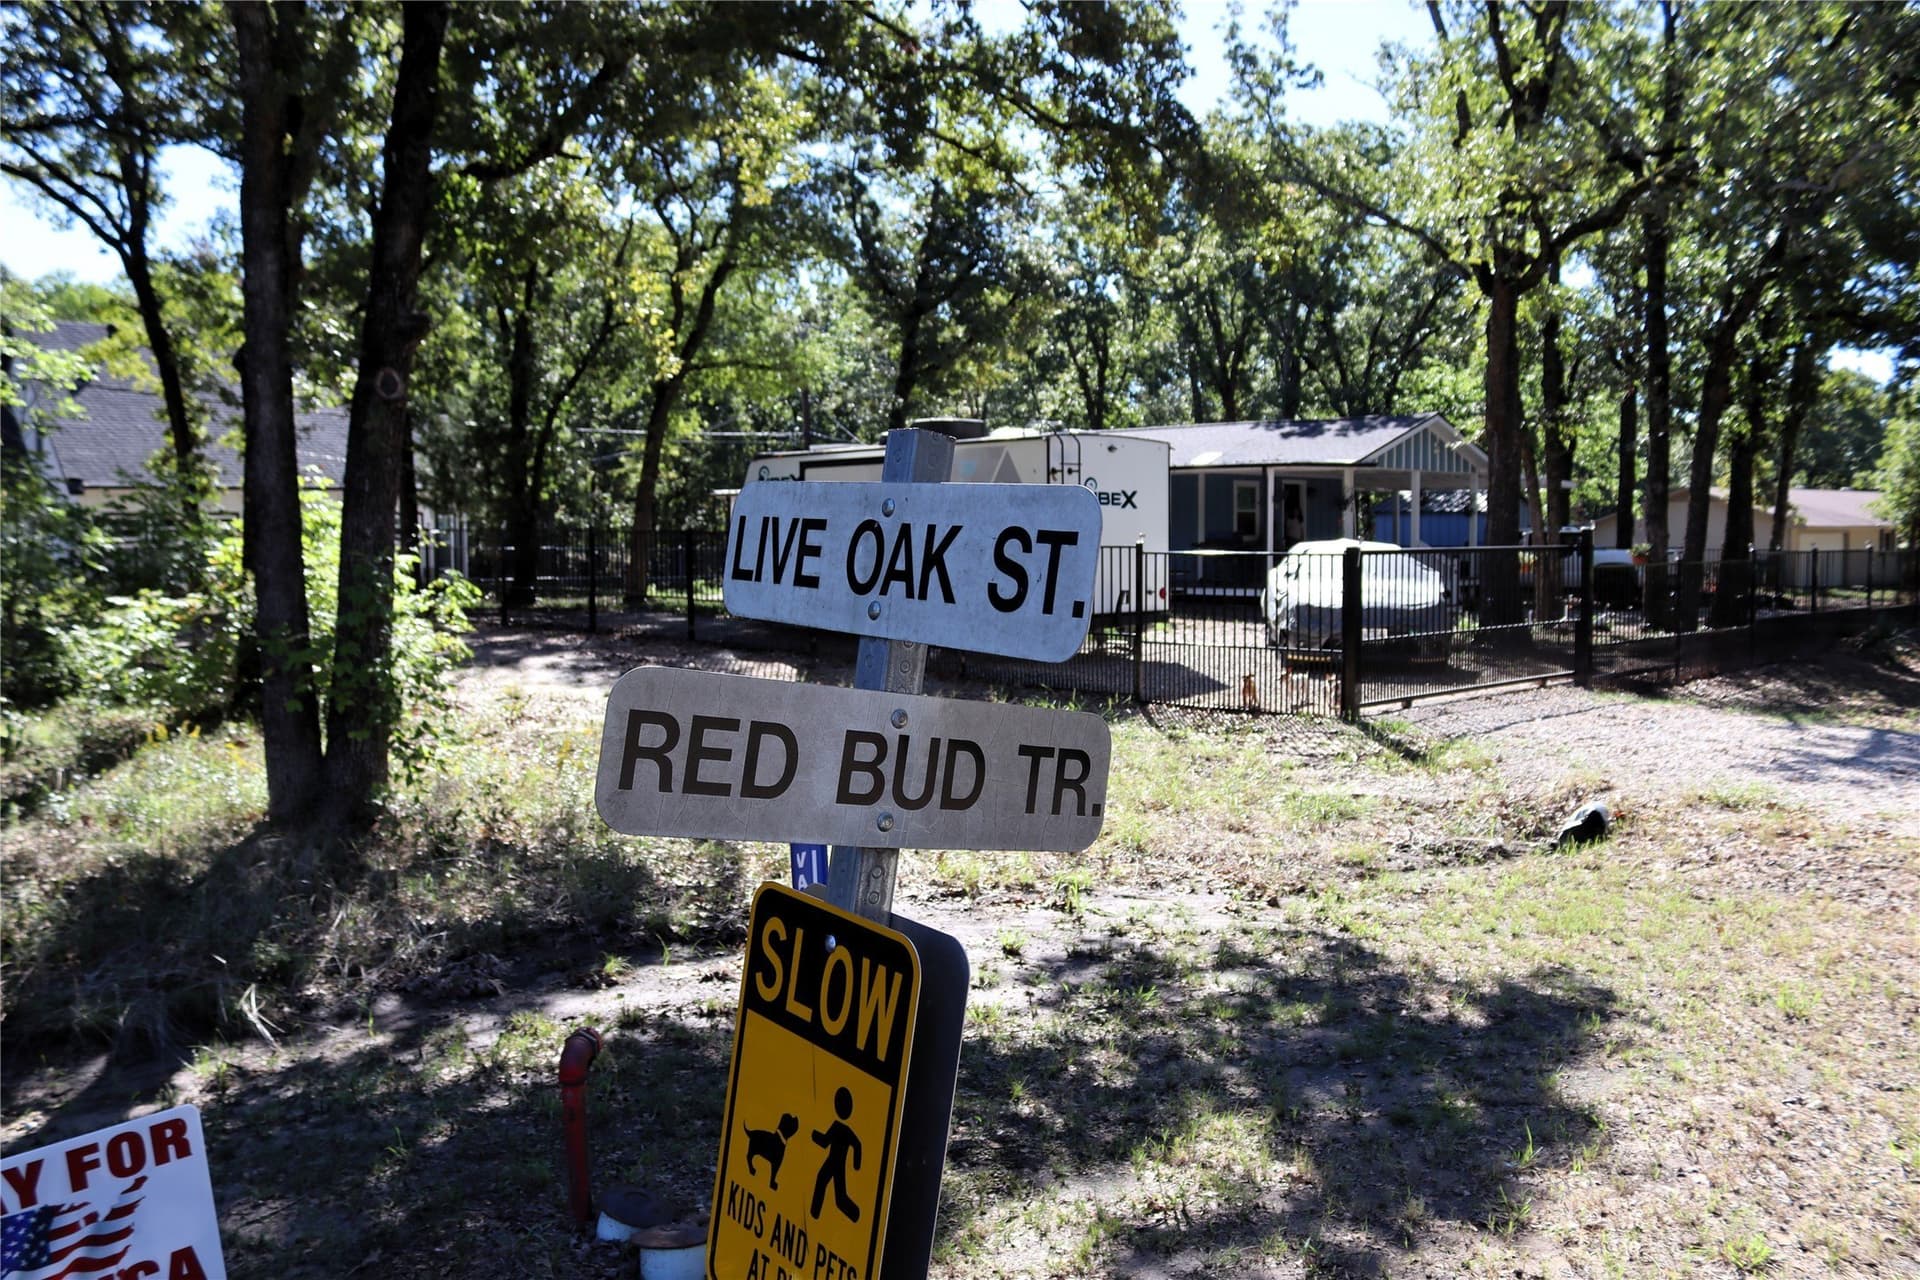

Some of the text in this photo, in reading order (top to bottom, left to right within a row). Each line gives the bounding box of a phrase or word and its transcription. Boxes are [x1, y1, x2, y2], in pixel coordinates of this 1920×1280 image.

[1094, 490, 1137, 509] BEX
[731, 515, 1085, 619] LIVE OAK ST.
[618, 709, 1102, 817] RED BUD TR.
[754, 916, 903, 1062] SLOW
[0, 1117, 193, 1216] Y FOR
[727, 1180, 766, 1239] KIDS
[769, 1213, 809, 1269] AND
[746, 1248, 770, 1280] AT
